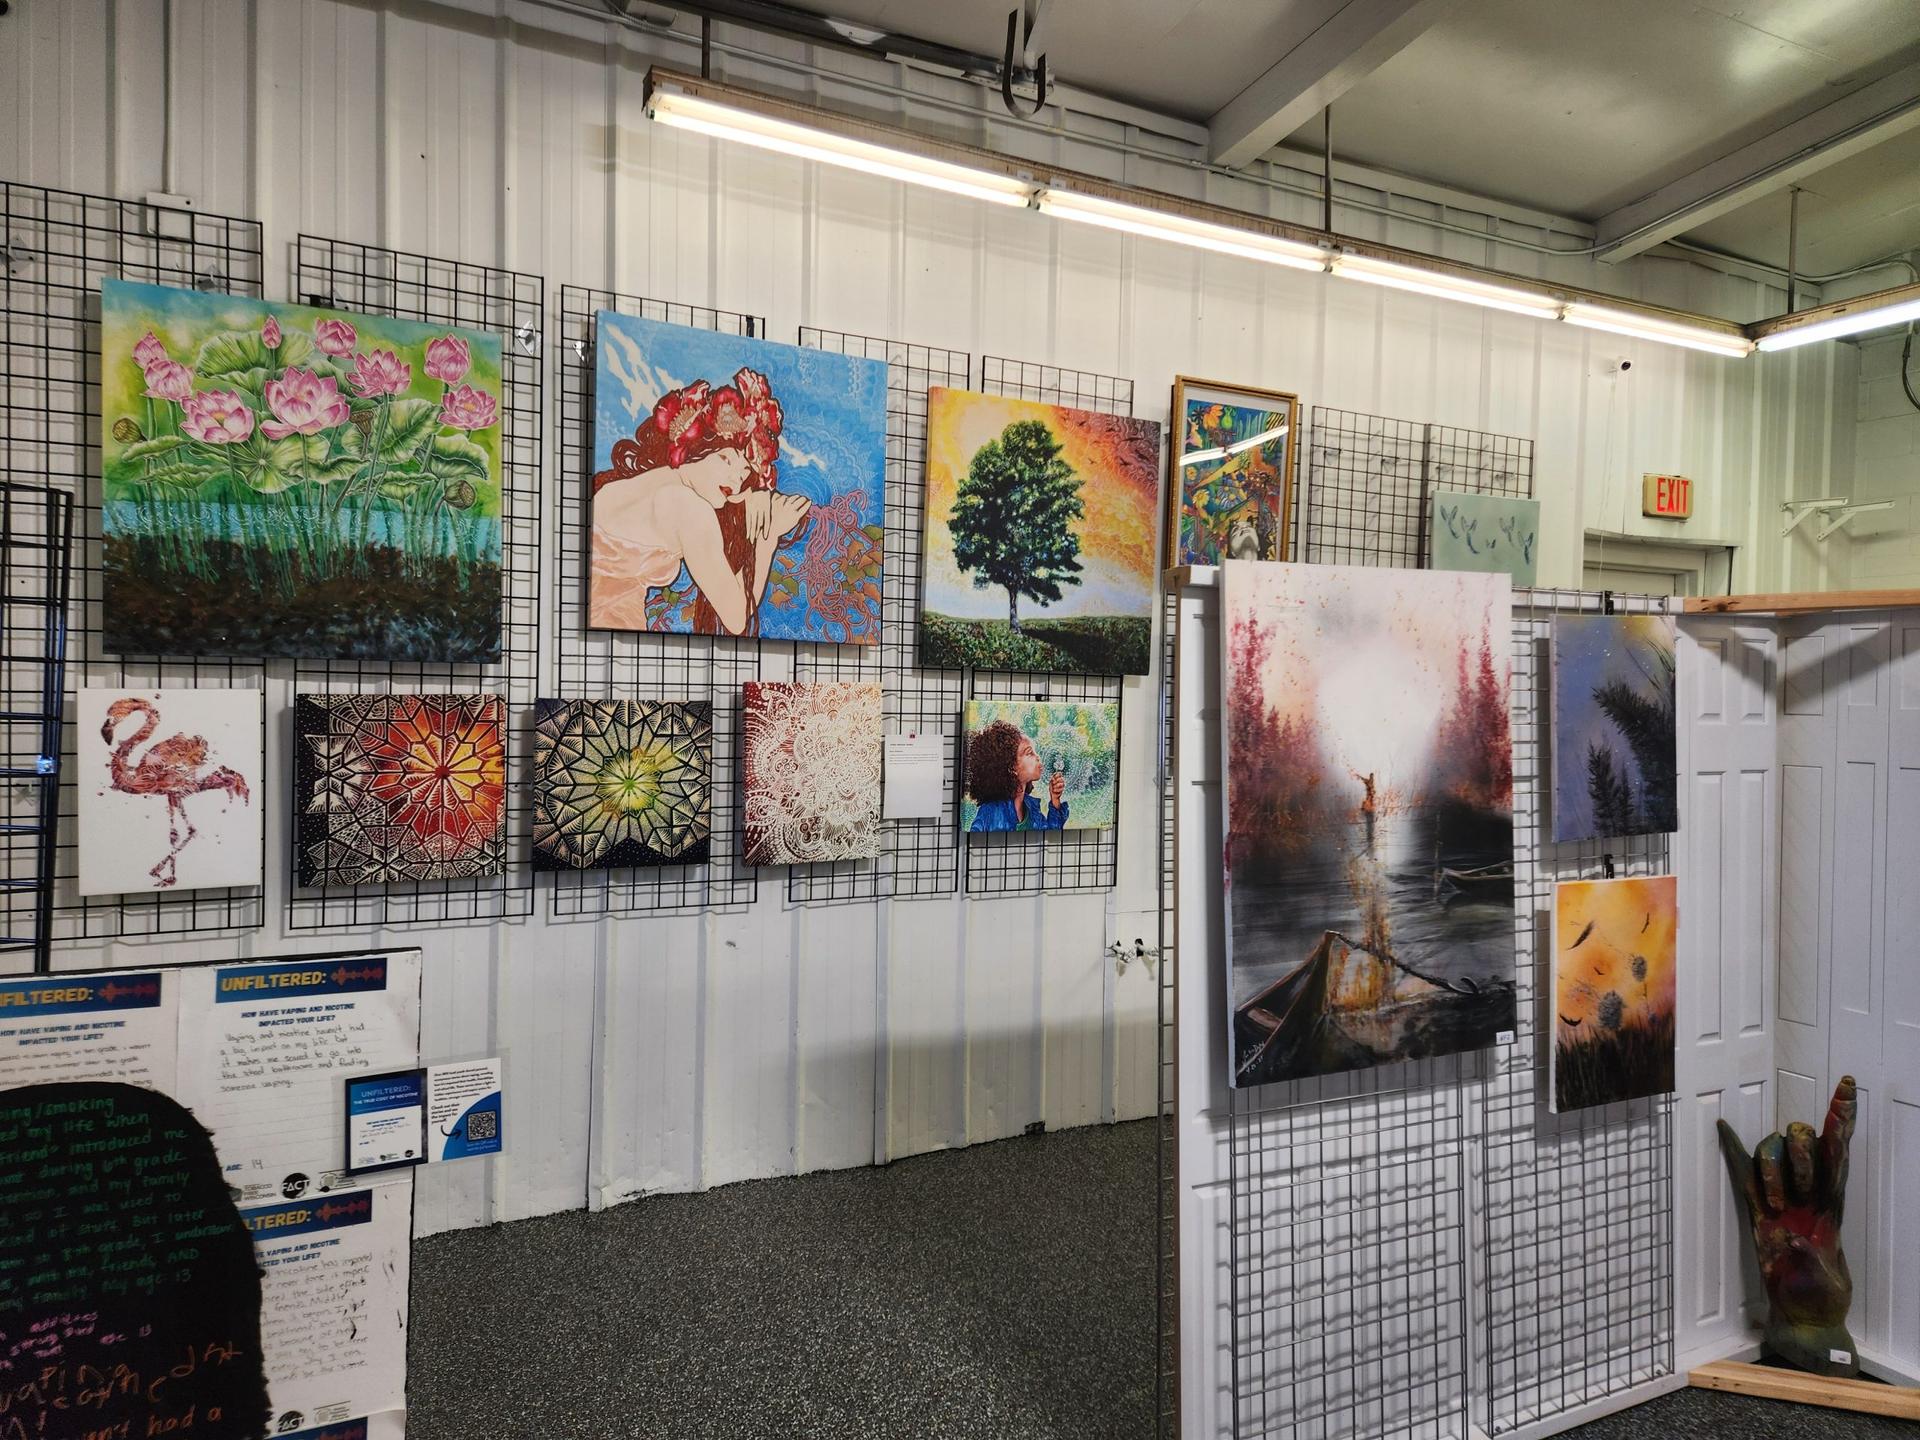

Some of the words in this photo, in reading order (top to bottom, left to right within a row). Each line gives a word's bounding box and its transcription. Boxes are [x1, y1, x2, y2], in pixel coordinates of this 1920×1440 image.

[1657, 477, 1689, 513] EXIT
[221, 971, 327, 992] UNFILTERED:
[259, 1009, 279, 1017] HAVE
[281, 1006, 307, 1015] VAPING
[309, 1005, 323, 1013] AND
[325, 1003, 355, 1012] NICOTINE
[258, 1018, 294, 1027] IMPACTED
[297, 1016, 315, 1025] YOUR
[317, 1014, 335, 1023] LIFE?
[69, 1128, 151, 1156] introduced
[134, 1146, 189, 1176] grade
[281, 1179, 310, 1193] FACT
[294, 1244, 309, 1252] AND
[310, 1238, 341, 1250] NICOTINE
